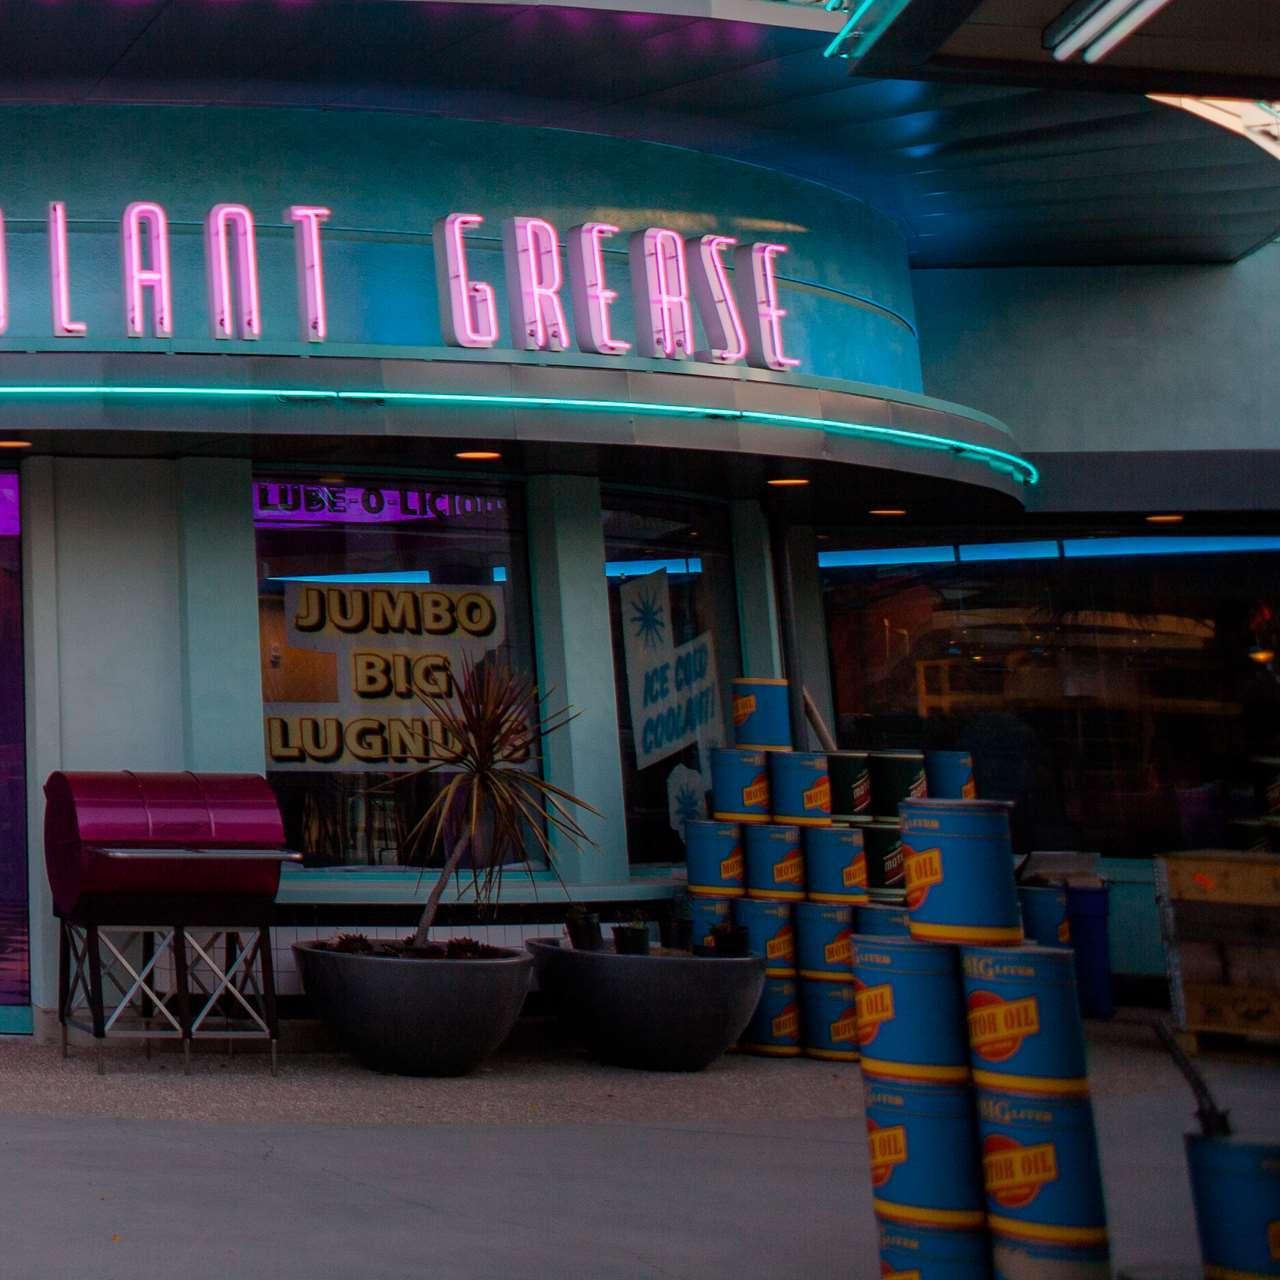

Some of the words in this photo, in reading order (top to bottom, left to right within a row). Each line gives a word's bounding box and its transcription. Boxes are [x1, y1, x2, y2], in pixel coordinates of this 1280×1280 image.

[436, 212, 802, 372] GREASE
[295, 588, 497, 636] JUMBO
[353, 652, 454, 699] BIG
[643, 661, 670, 709] ICE
[267, 717, 531, 763] LUGNUS
[865, 990, 890, 1014] OIL
[1003, 1004, 1035, 1030] OIL
[879, 1133, 901, 1156] OIL
[1021, 1151, 1052, 1177] OIL
